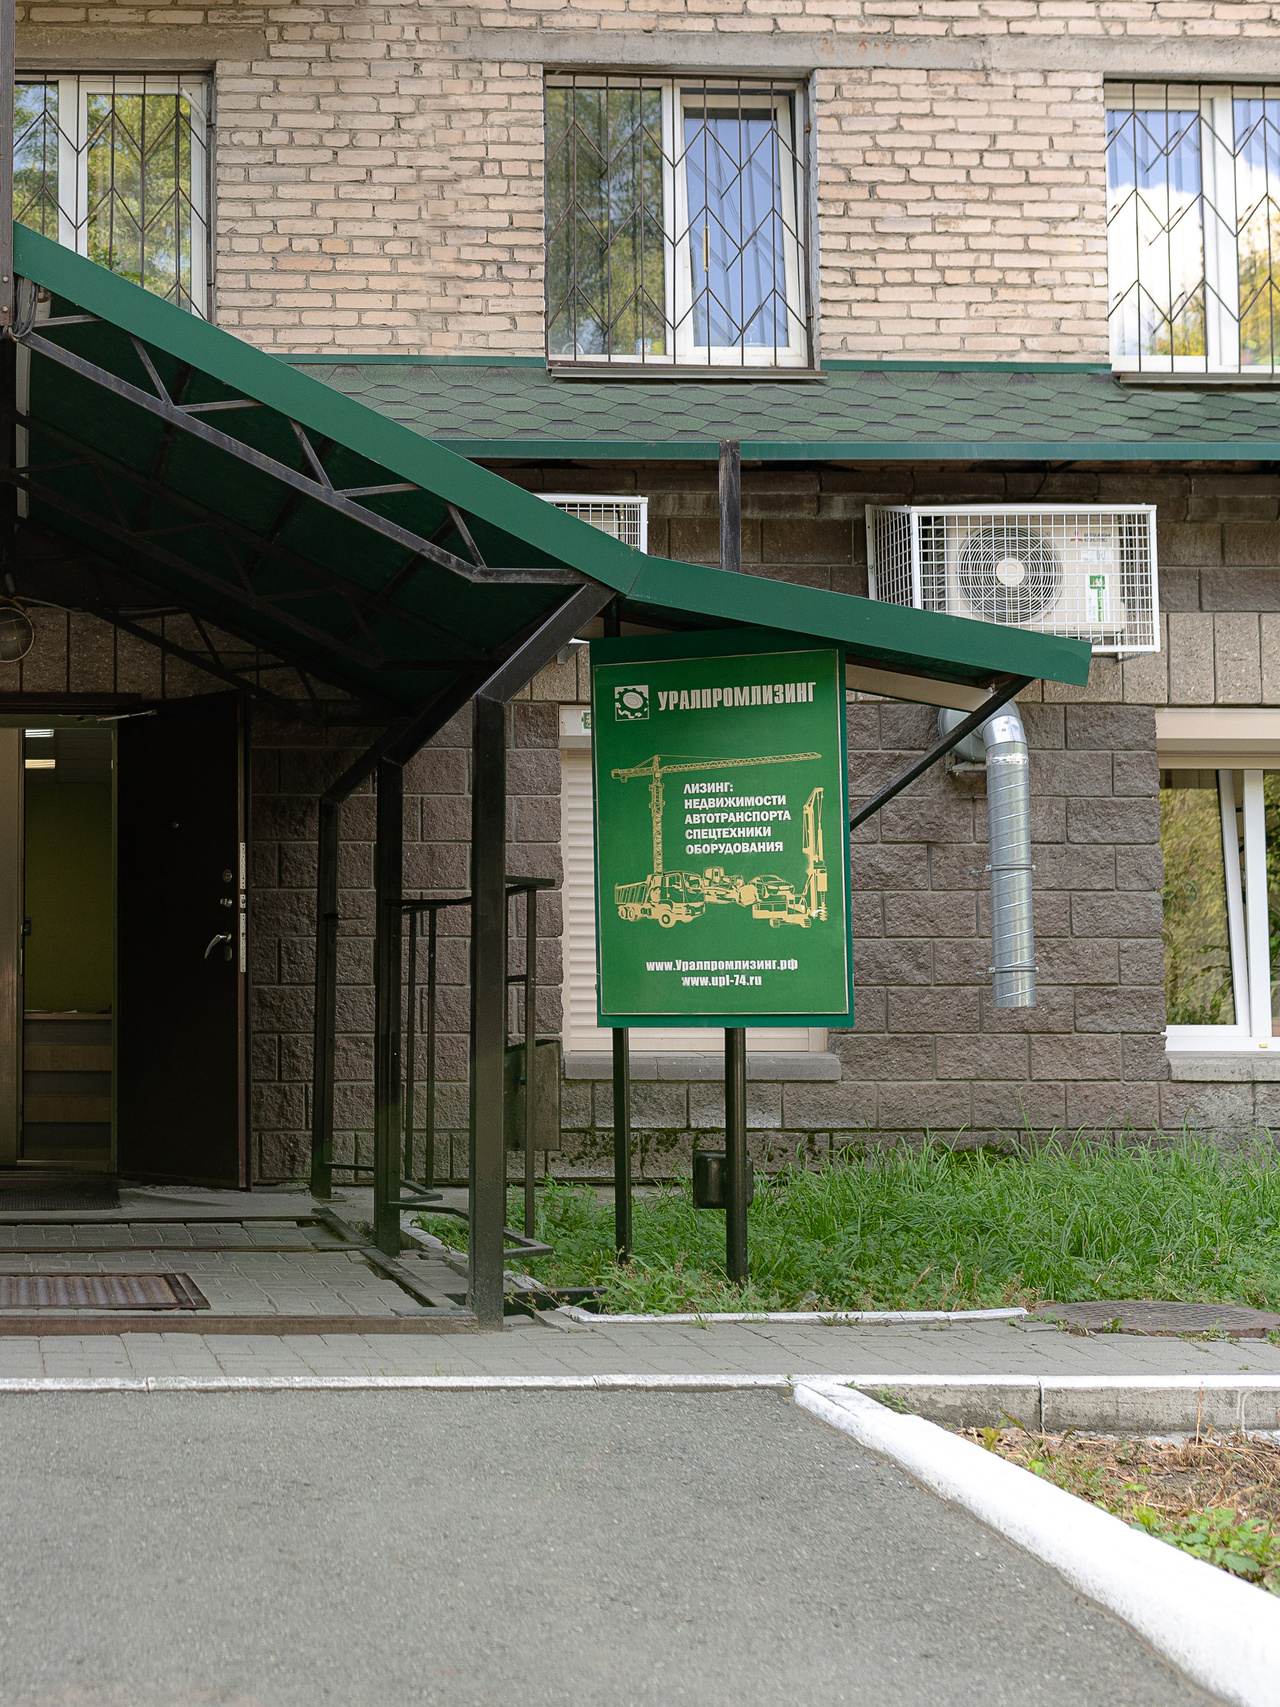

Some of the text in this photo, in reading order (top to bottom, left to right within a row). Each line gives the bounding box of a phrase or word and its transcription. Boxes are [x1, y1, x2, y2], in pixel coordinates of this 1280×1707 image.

[657, 682, 817, 711] УРАЛПРОМЛИЗИНГ
[683, 782, 734, 794] ЛИЗИНГ:
[684, 795, 787, 810] НЕДВИЖИМОСТИ
[684, 810, 792, 825] АВТОТРАНСПОРТА
[685, 826, 772, 840] СПЕЦТЕХНИКИ
[685, 841, 784, 855] ОБОРУДОВАНИЯ
[646, 958, 799, 972] www.Уралпромлизинг.рф
[681, 974, 763, 988] www.upl-74.ru
